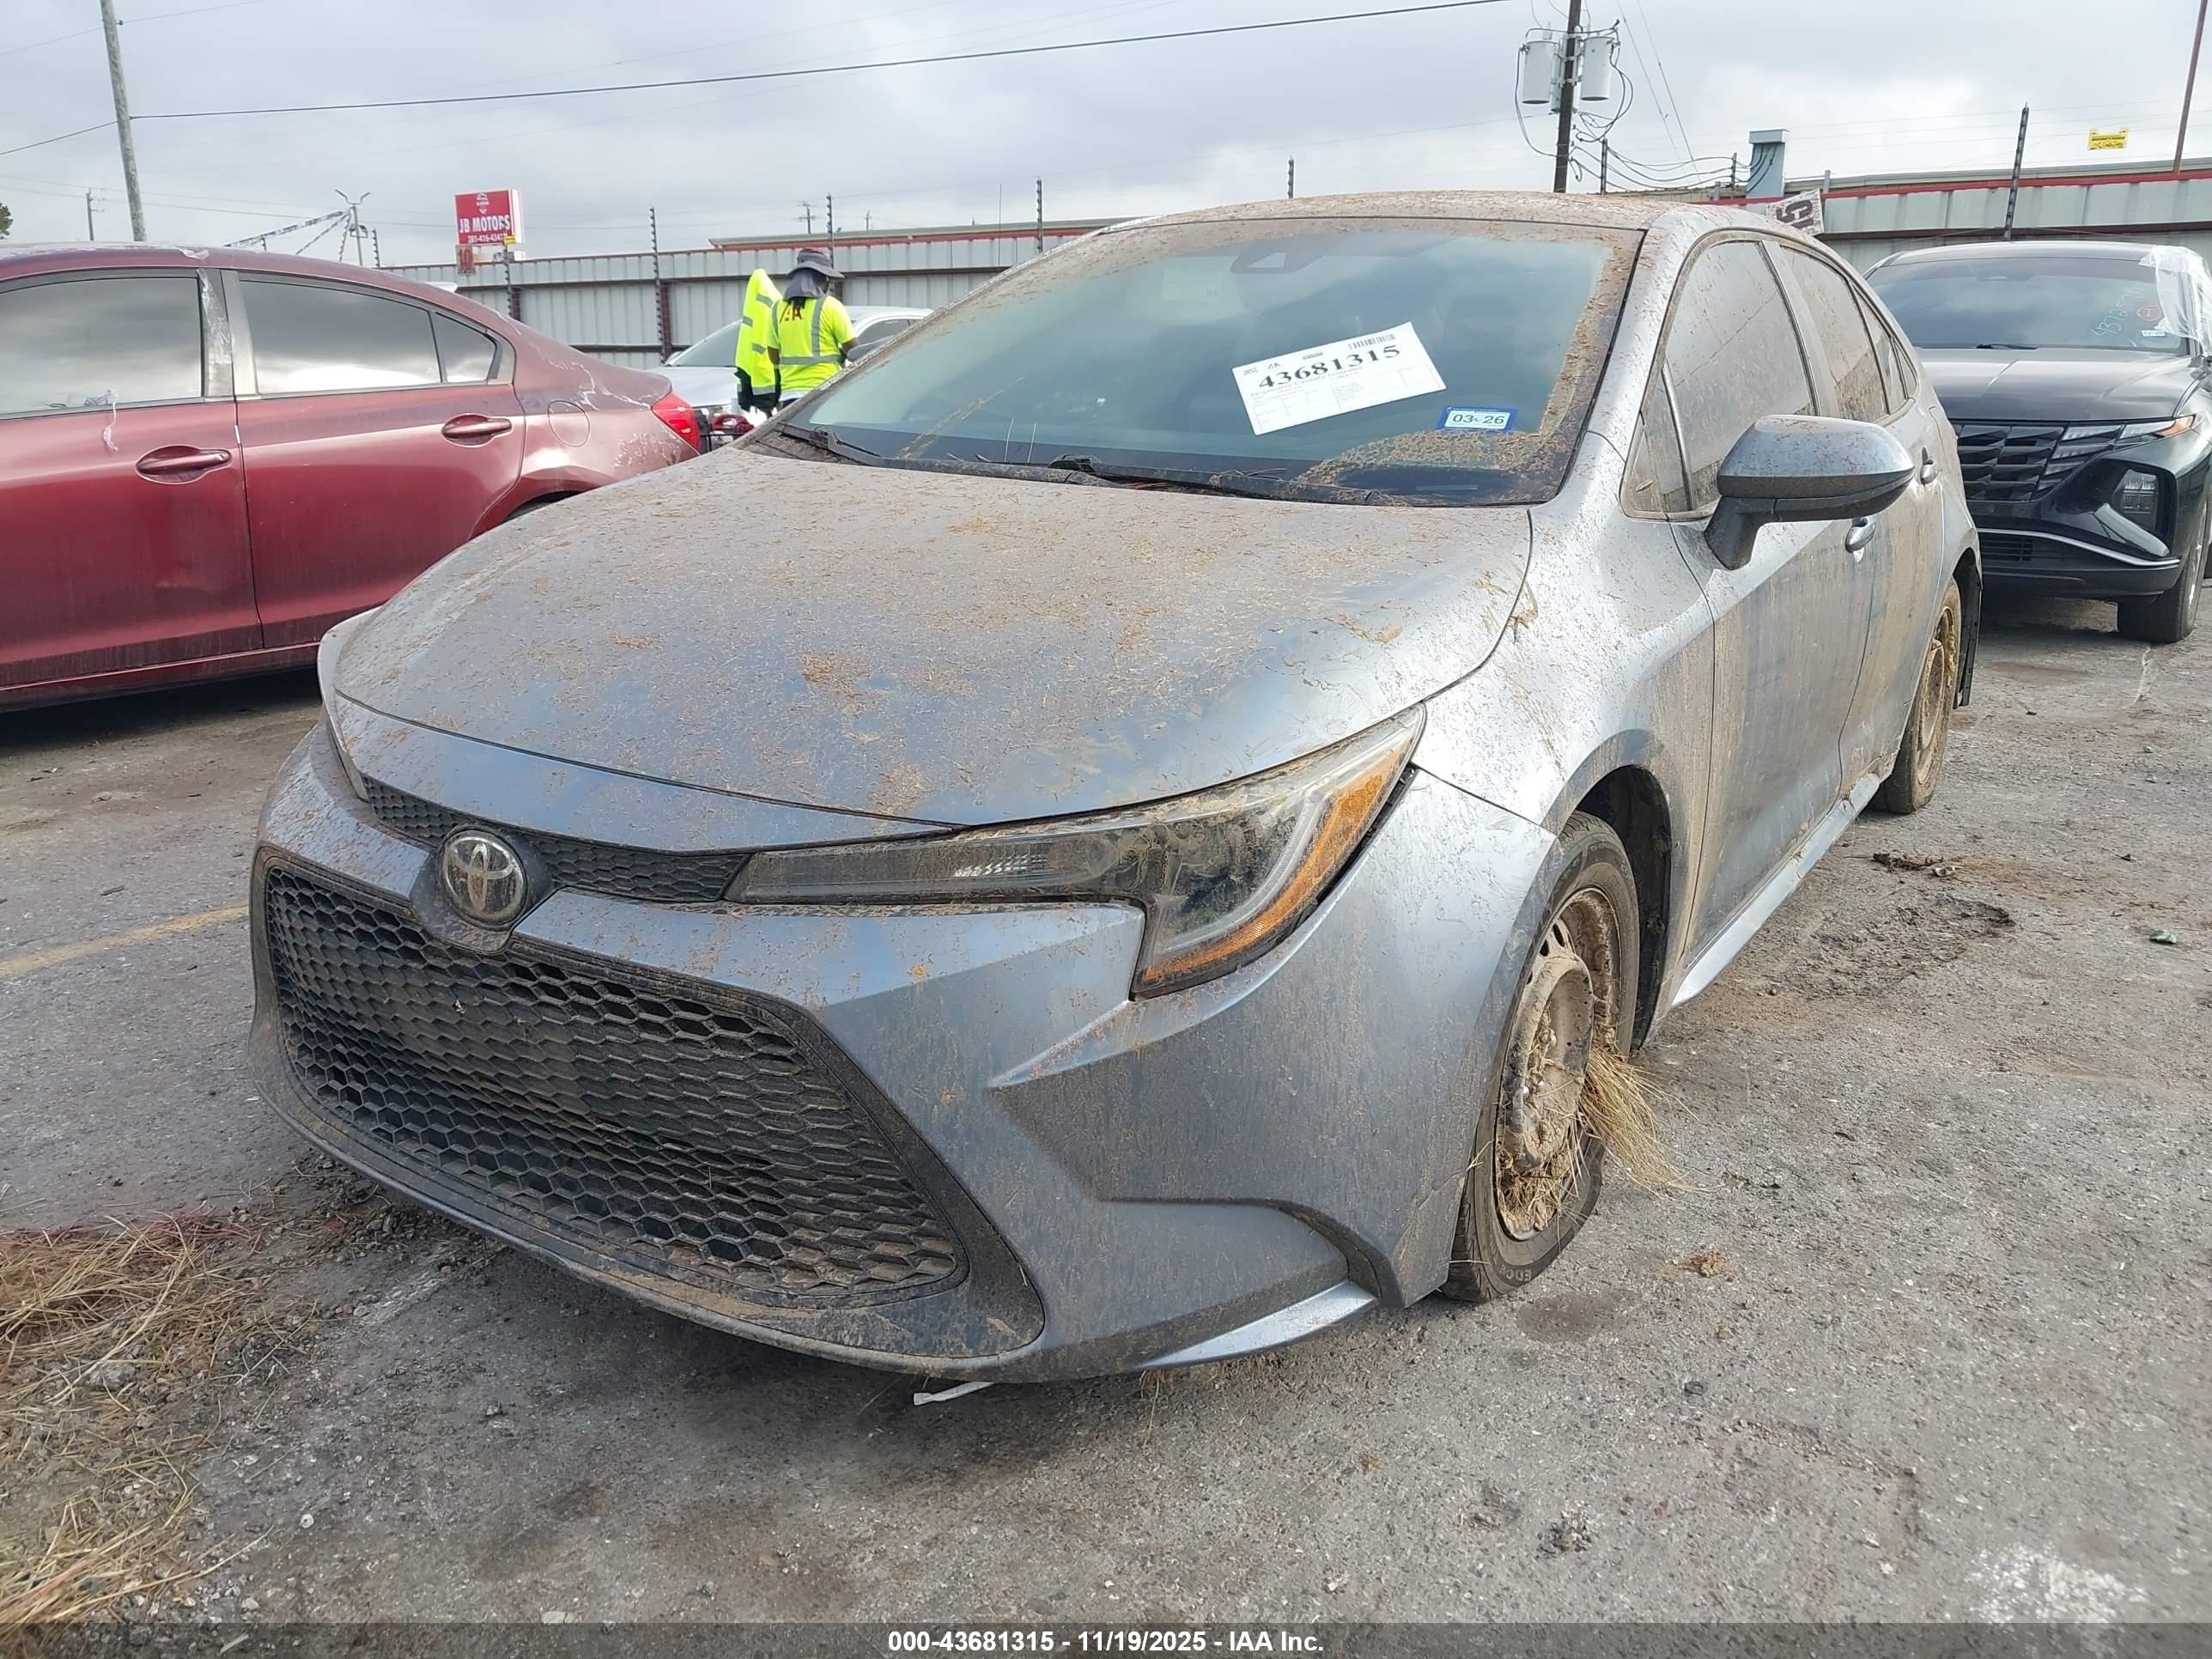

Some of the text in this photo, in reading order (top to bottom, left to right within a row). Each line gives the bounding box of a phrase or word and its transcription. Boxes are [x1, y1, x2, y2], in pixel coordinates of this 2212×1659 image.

[459, 215, 510, 234] JB MOTORS
[1258, 344, 1401, 387] 43681315
